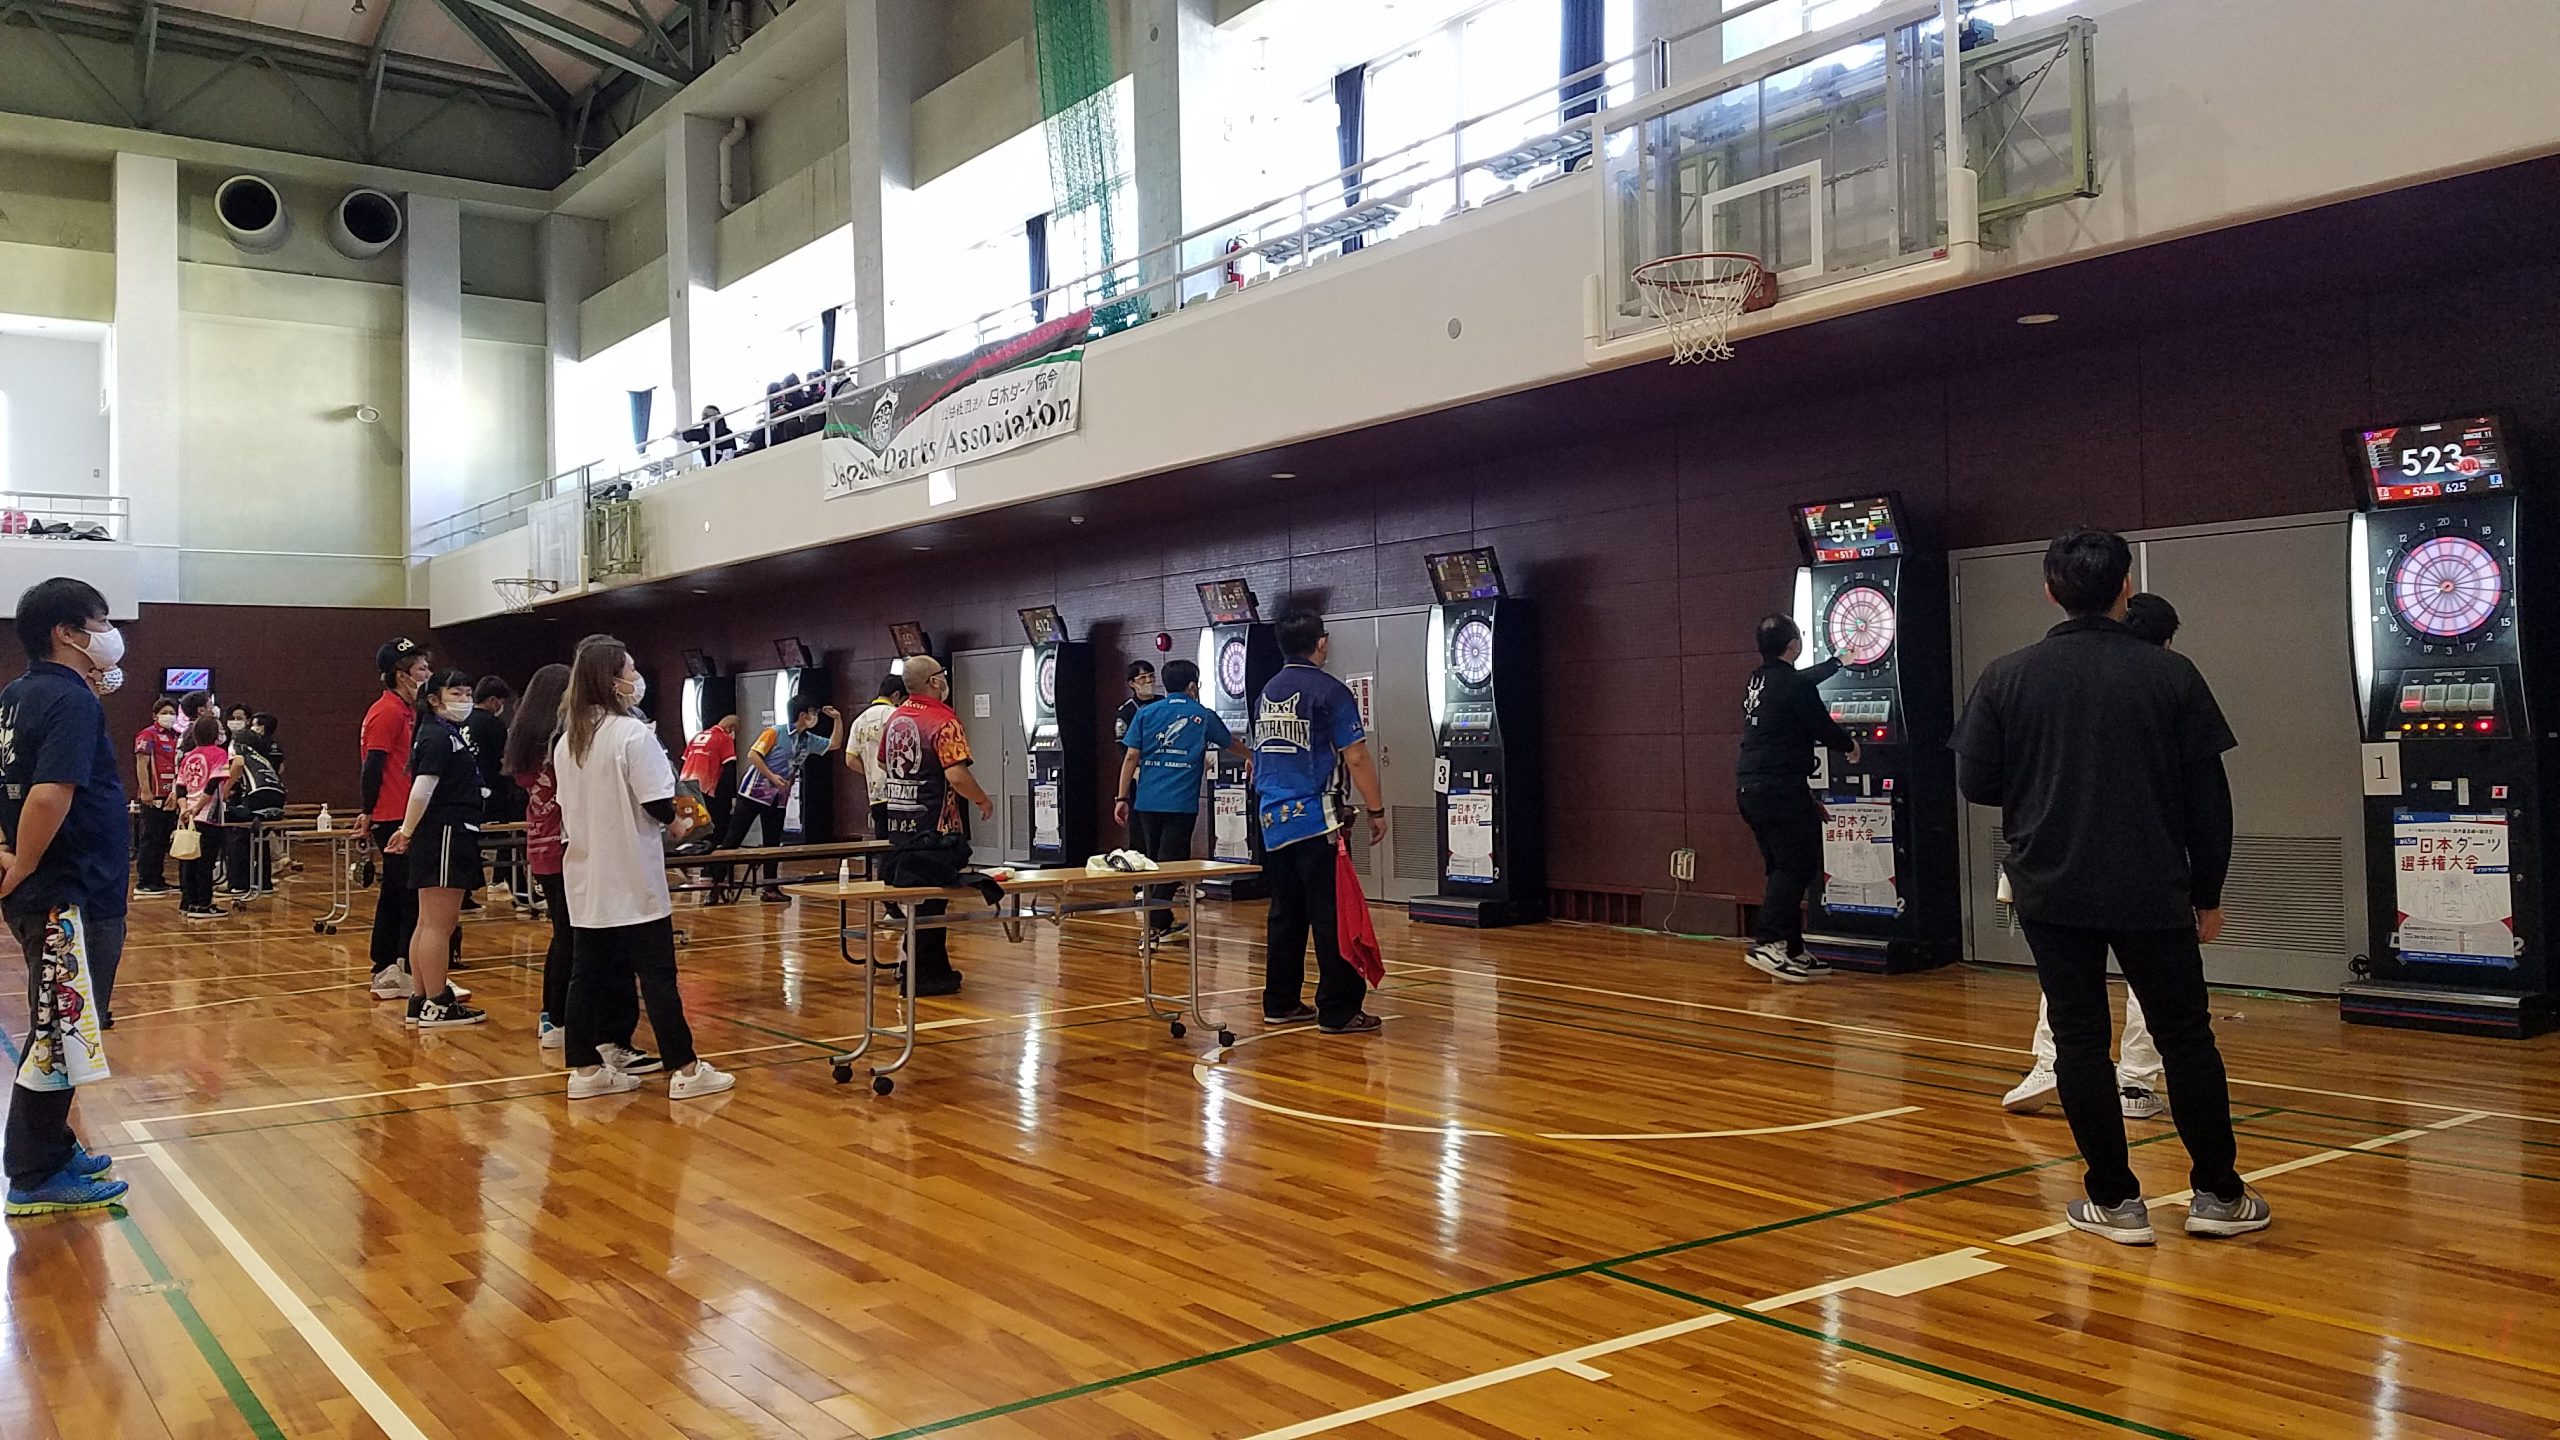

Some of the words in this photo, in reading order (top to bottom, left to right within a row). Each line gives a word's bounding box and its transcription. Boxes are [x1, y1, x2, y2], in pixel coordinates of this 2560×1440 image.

[831, 457, 878, 490] Japan
[883, 441, 936, 474] Darts
[944, 397, 1073, 458] Association
[2402, 443, 2462, 476] 523
[2412, 485, 2434, 497] 523
[2445, 482, 2467, 493] 625
[2437, 517, 2450, 527] 20
[1840, 550, 1854, 559] 517
[1861, 548, 1875, 557] 627
[2500, 617, 2511, 627] 15
[2466, 643, 2477, 653] 17
[1029, 759, 1035, 774] 5
[2374, 756, 2389, 780] 1
[1438, 765, 1447, 785] 3
[1838, 814, 1888, 828] 日本ダーツ
[1825, 828, 1875, 842] 選手権大会
[2420, 837, 2502, 854] 日本ダーツ
[2401, 854, 2479, 871] 選手権大会
